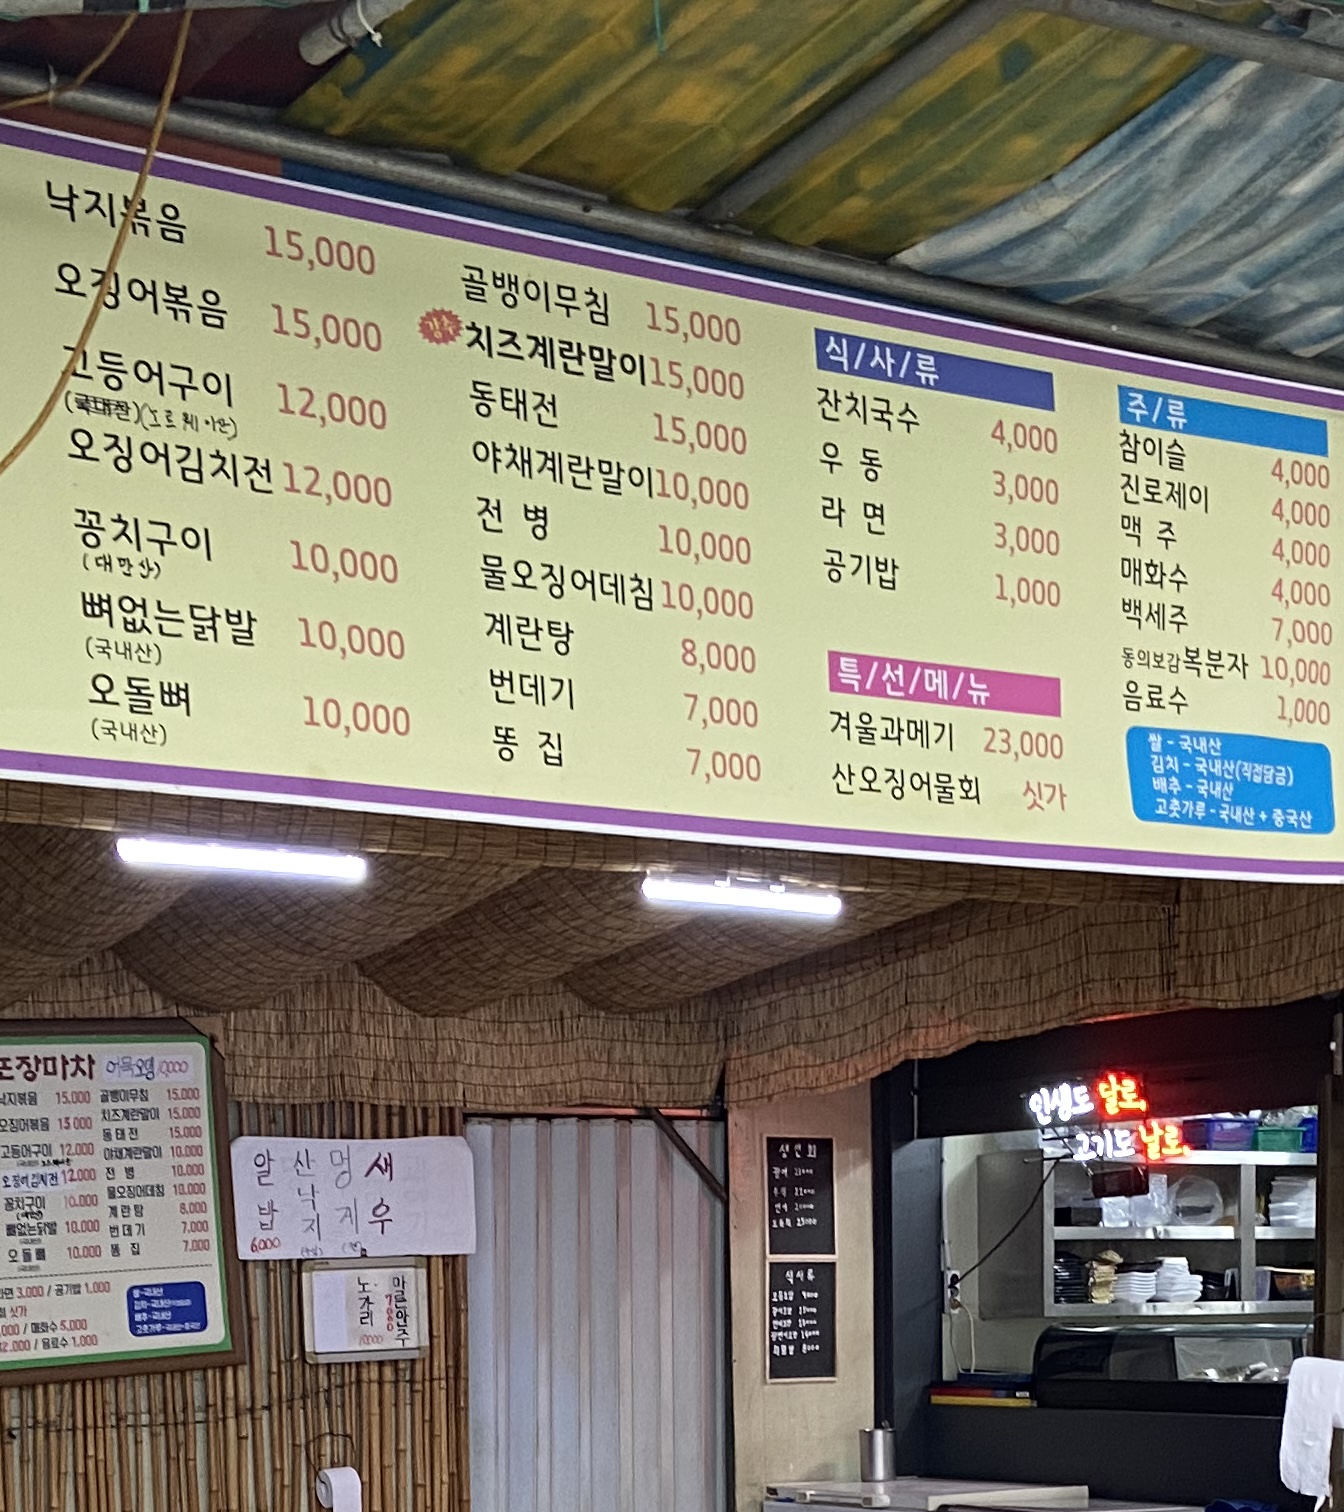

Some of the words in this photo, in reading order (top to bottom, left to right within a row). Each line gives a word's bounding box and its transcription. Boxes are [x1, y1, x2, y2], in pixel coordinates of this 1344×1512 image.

[45, 180, 188, 245] 낙지볶음
[262, 225, 377, 277] 15,000
[54, 261, 229, 331] 오징어볶음
[270, 303, 383, 353] 15,000
[461, 263, 611, 328] 골뱅이무침
[645, 301, 742, 346] 15,000
[464, 321, 647, 387] 치즈계란말이
[649, 356, 745, 401] 15,000
[824, 334, 941, 387] 식/사/류
[60, 344, 236, 409] 고등어구이
[275, 382, 389, 432] 12,000
[1125, 391, 1189, 430] 주/류
[468, 380, 560, 429] 동태전
[652, 412, 748, 456] 15,000
[816, 386, 922, 434] 잔치국수
[990, 417, 1059, 455] 4,000
[67, 427, 275, 497] 오징어김치전
[281, 461, 394, 509] 12,000
[471, 439, 655, 500] 야채계란말이
[656, 468, 750, 511] 10,000
[1118, 428, 1188, 473] 참이슬
[1270, 456, 1331, 491] 4,000
[992, 470, 1059, 507] 3,000
[1120, 472, 1211, 514] 진로제이
[1270, 497, 1331, 530] 4,000
[73, 507, 215, 562] 꽁치구이
[289, 539, 399, 586] 10,000
[657, 524, 753, 567] 10,000
[993, 521, 1061, 558] 3,000
[1270, 537, 1332, 570] 4,000
[479, 554, 655, 613] 물오징어데침
[660, 579, 754, 621] 10,000
[823, 548, 900, 592] 공기밥
[994, 572, 1062, 609] 1,000
[1120, 555, 1190, 592] 매화수
[1270, 576, 1332, 610] 4,000
[81, 592, 258, 650] 뼈없는닭발
[297, 616, 406, 663] 10,000
[484, 611, 575, 657] 계란탕
[681, 637, 757, 675] 8,000
[1120, 596, 1190, 634] 백세주
[1271, 616, 1333, 648] 7,000
[84, 636, 163, 668] (국내산)
[1258, 653, 1332, 688] 10,000
[87, 671, 193, 718] 오돌뼈
[302, 695, 412, 738] 10,000
[488, 667, 576, 710] 번데기
[683, 691, 759, 730] 7,000
[836, 655, 993, 707] 특/선/메/뉴
[1121, 680, 1190, 716] 음료수
[1276, 694, 1331, 727] 1,000
[90, 716, 168, 749] (국내산)
[829, 709, 957, 754] 겨울과메기
[982, 725, 1065, 762] 23,000
[1178, 734, 1222, 756] 국내산
[686, 747, 762, 783] 7,000
[831, 761, 983, 807] 산오징어물회
[1022, 777, 1070, 813] 싯가
[1150, 754, 1179, 774] 김치
[1152, 777, 1182, 795] 배추
[1196, 779, 1234, 802] 국내산
[1218, 804, 1255, 826] 국내산
[1029, 1083, 1094, 1125] 인생도
[1073, 1129, 1135, 1160] 고기도
